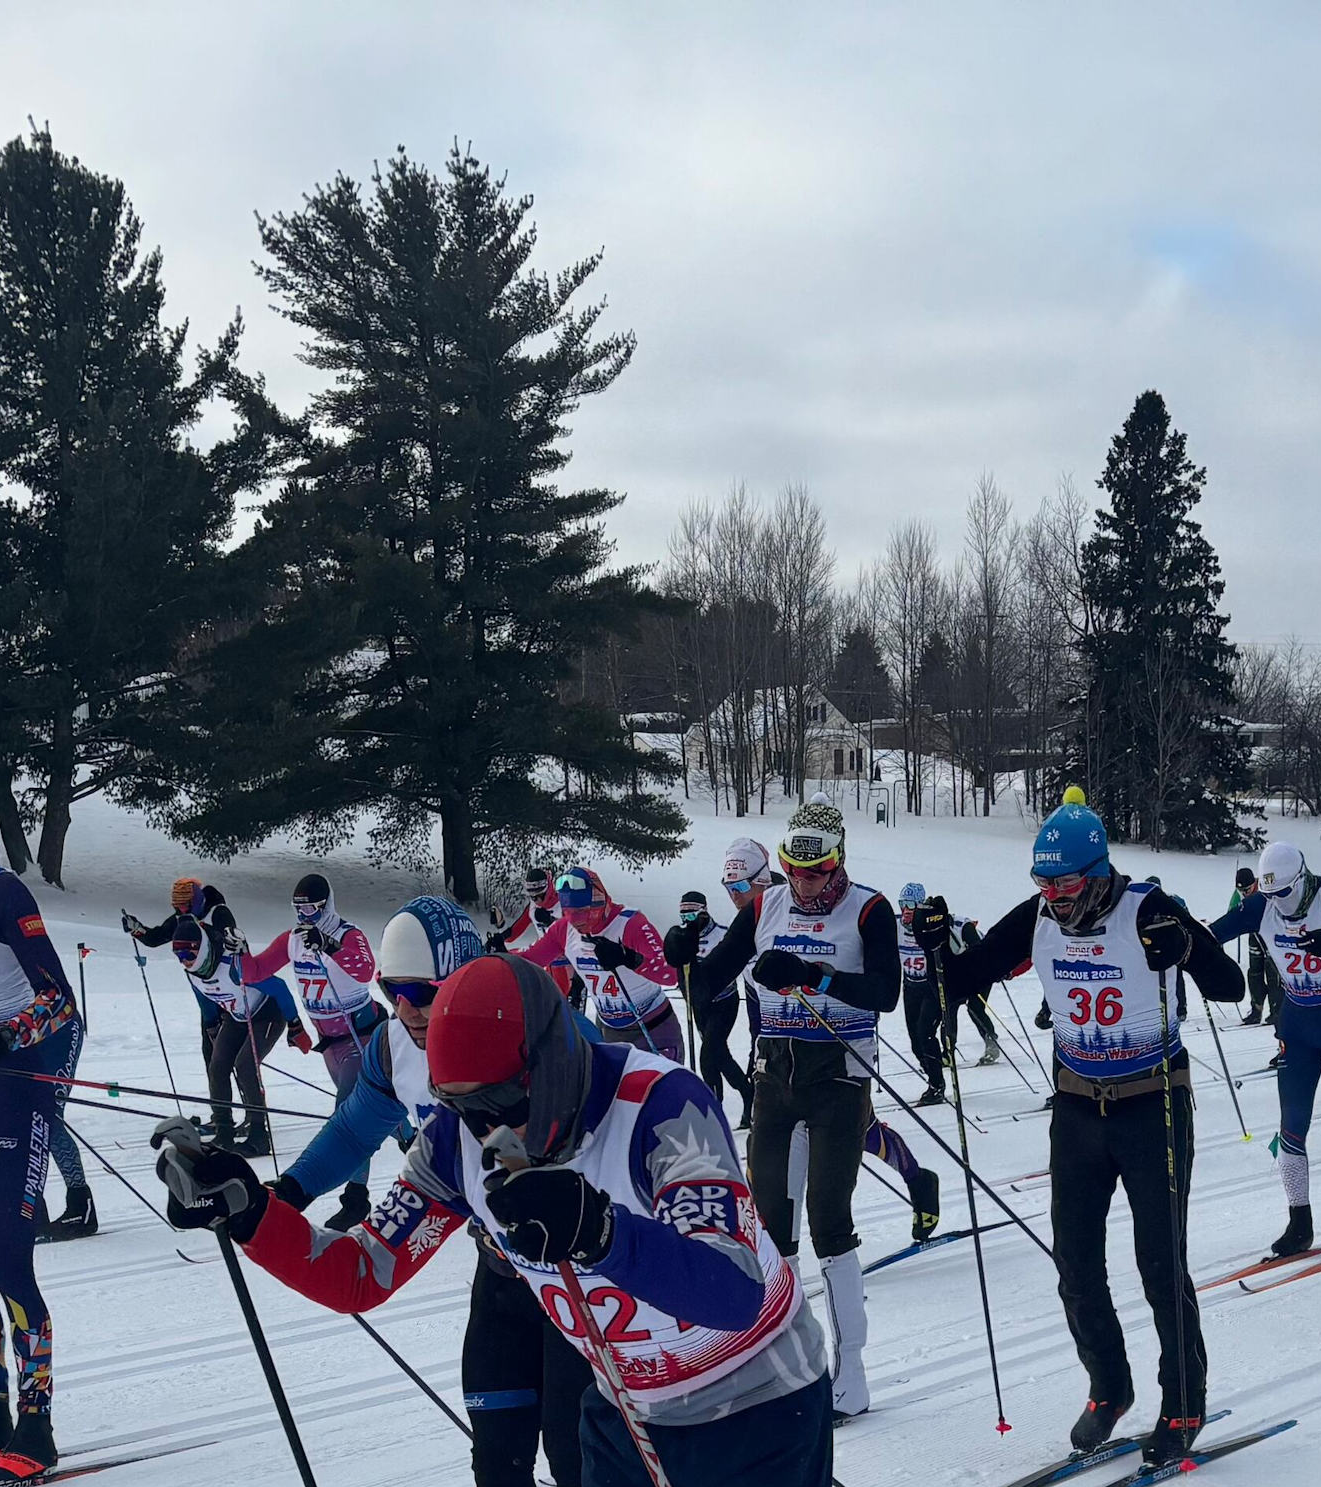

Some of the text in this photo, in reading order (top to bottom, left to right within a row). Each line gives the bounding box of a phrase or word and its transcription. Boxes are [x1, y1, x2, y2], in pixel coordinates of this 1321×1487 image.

[903, 957, 925, 971] 45
[1055, 968, 1122, 980] NOQUE 2025
[298, 978, 328, 1001] 77
[585, 975, 620, 997] 74
[1067, 986, 1124, 1026] 36
[24, 1110, 45, 1198] PATHLETICS
